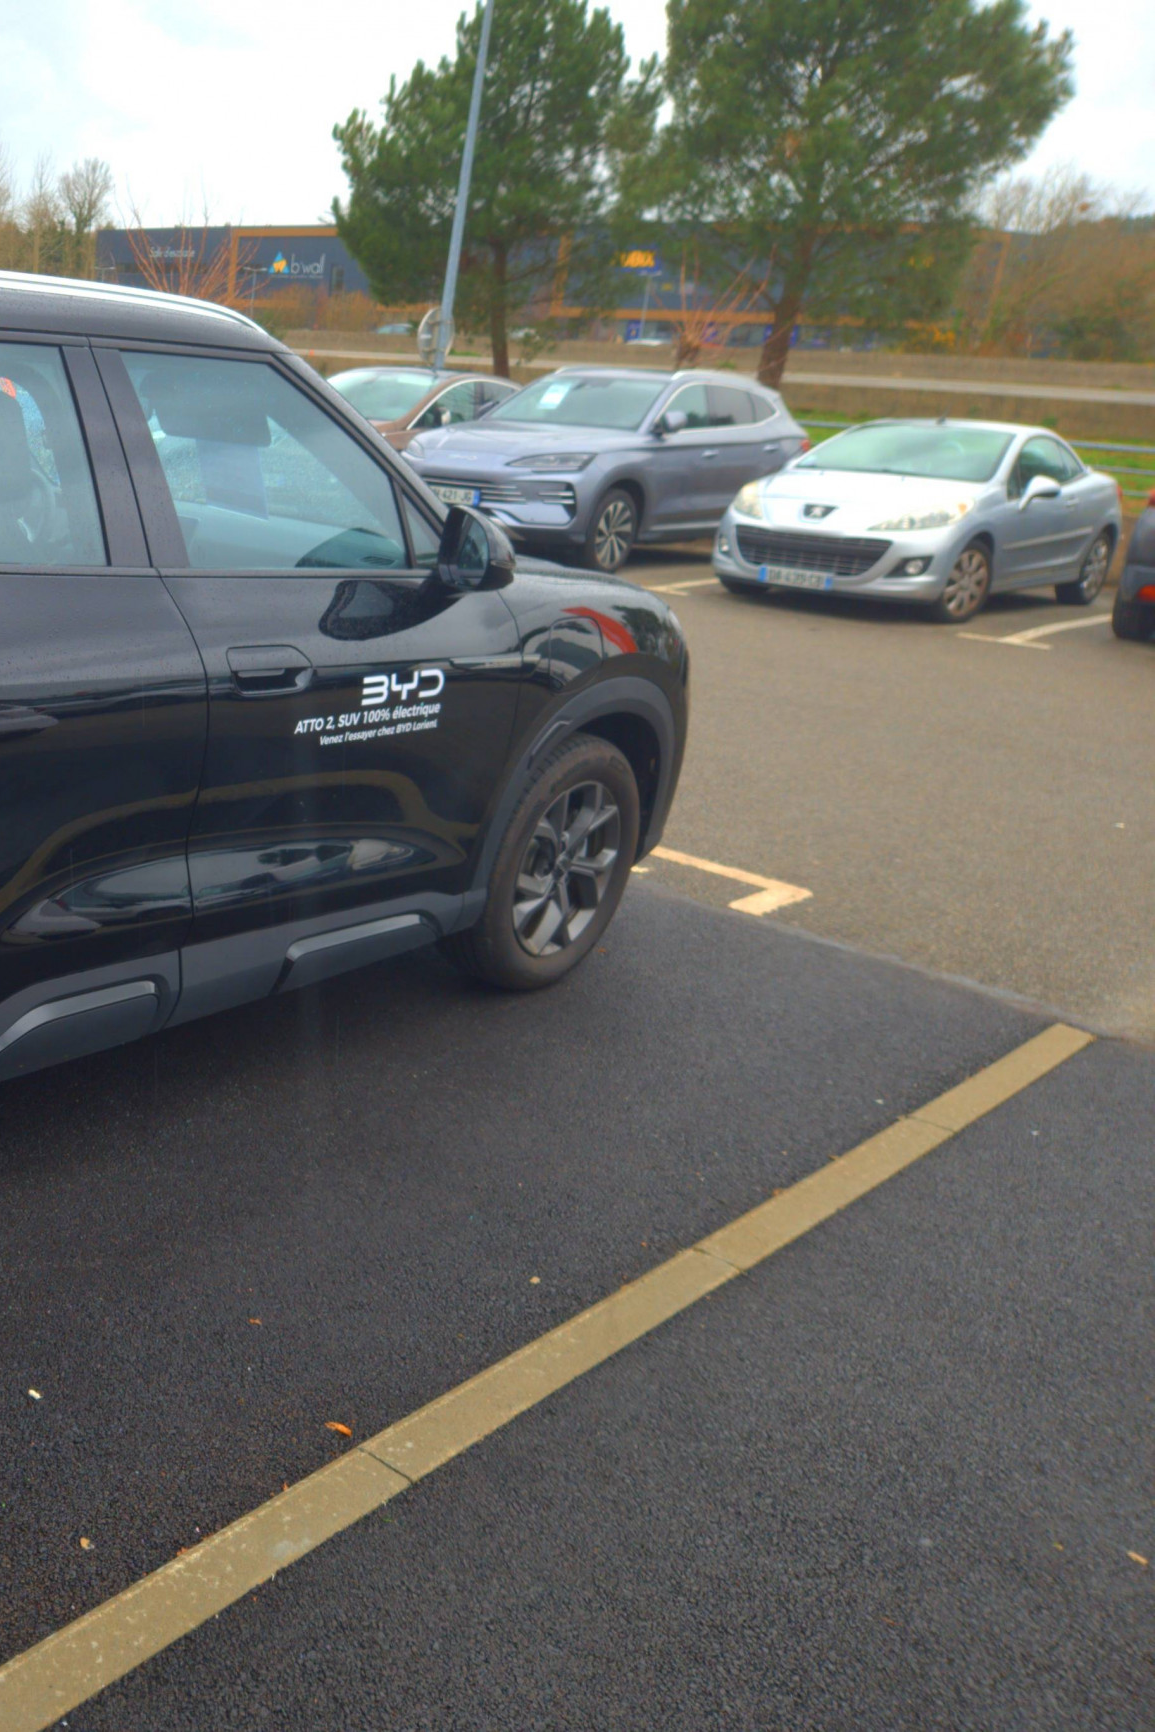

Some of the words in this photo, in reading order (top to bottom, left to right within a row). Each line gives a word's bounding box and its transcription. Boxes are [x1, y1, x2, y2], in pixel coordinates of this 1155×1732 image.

[361, 668, 445, 706] BYD
[294, 718, 324, 735] ATTO
[326, 715, 335, 730] 2,
[338, 712, 361, 728] SUV
[363, 708, 390, 725] 100%
[392, 702, 441, 720] électrique
[319, 732, 344, 746] Venez
[344, 728, 377, 742] l'essayer
[377, 725, 395, 738] chez
[396, 722, 412, 734] BYD
[413, 718, 438, 731] Lorient
